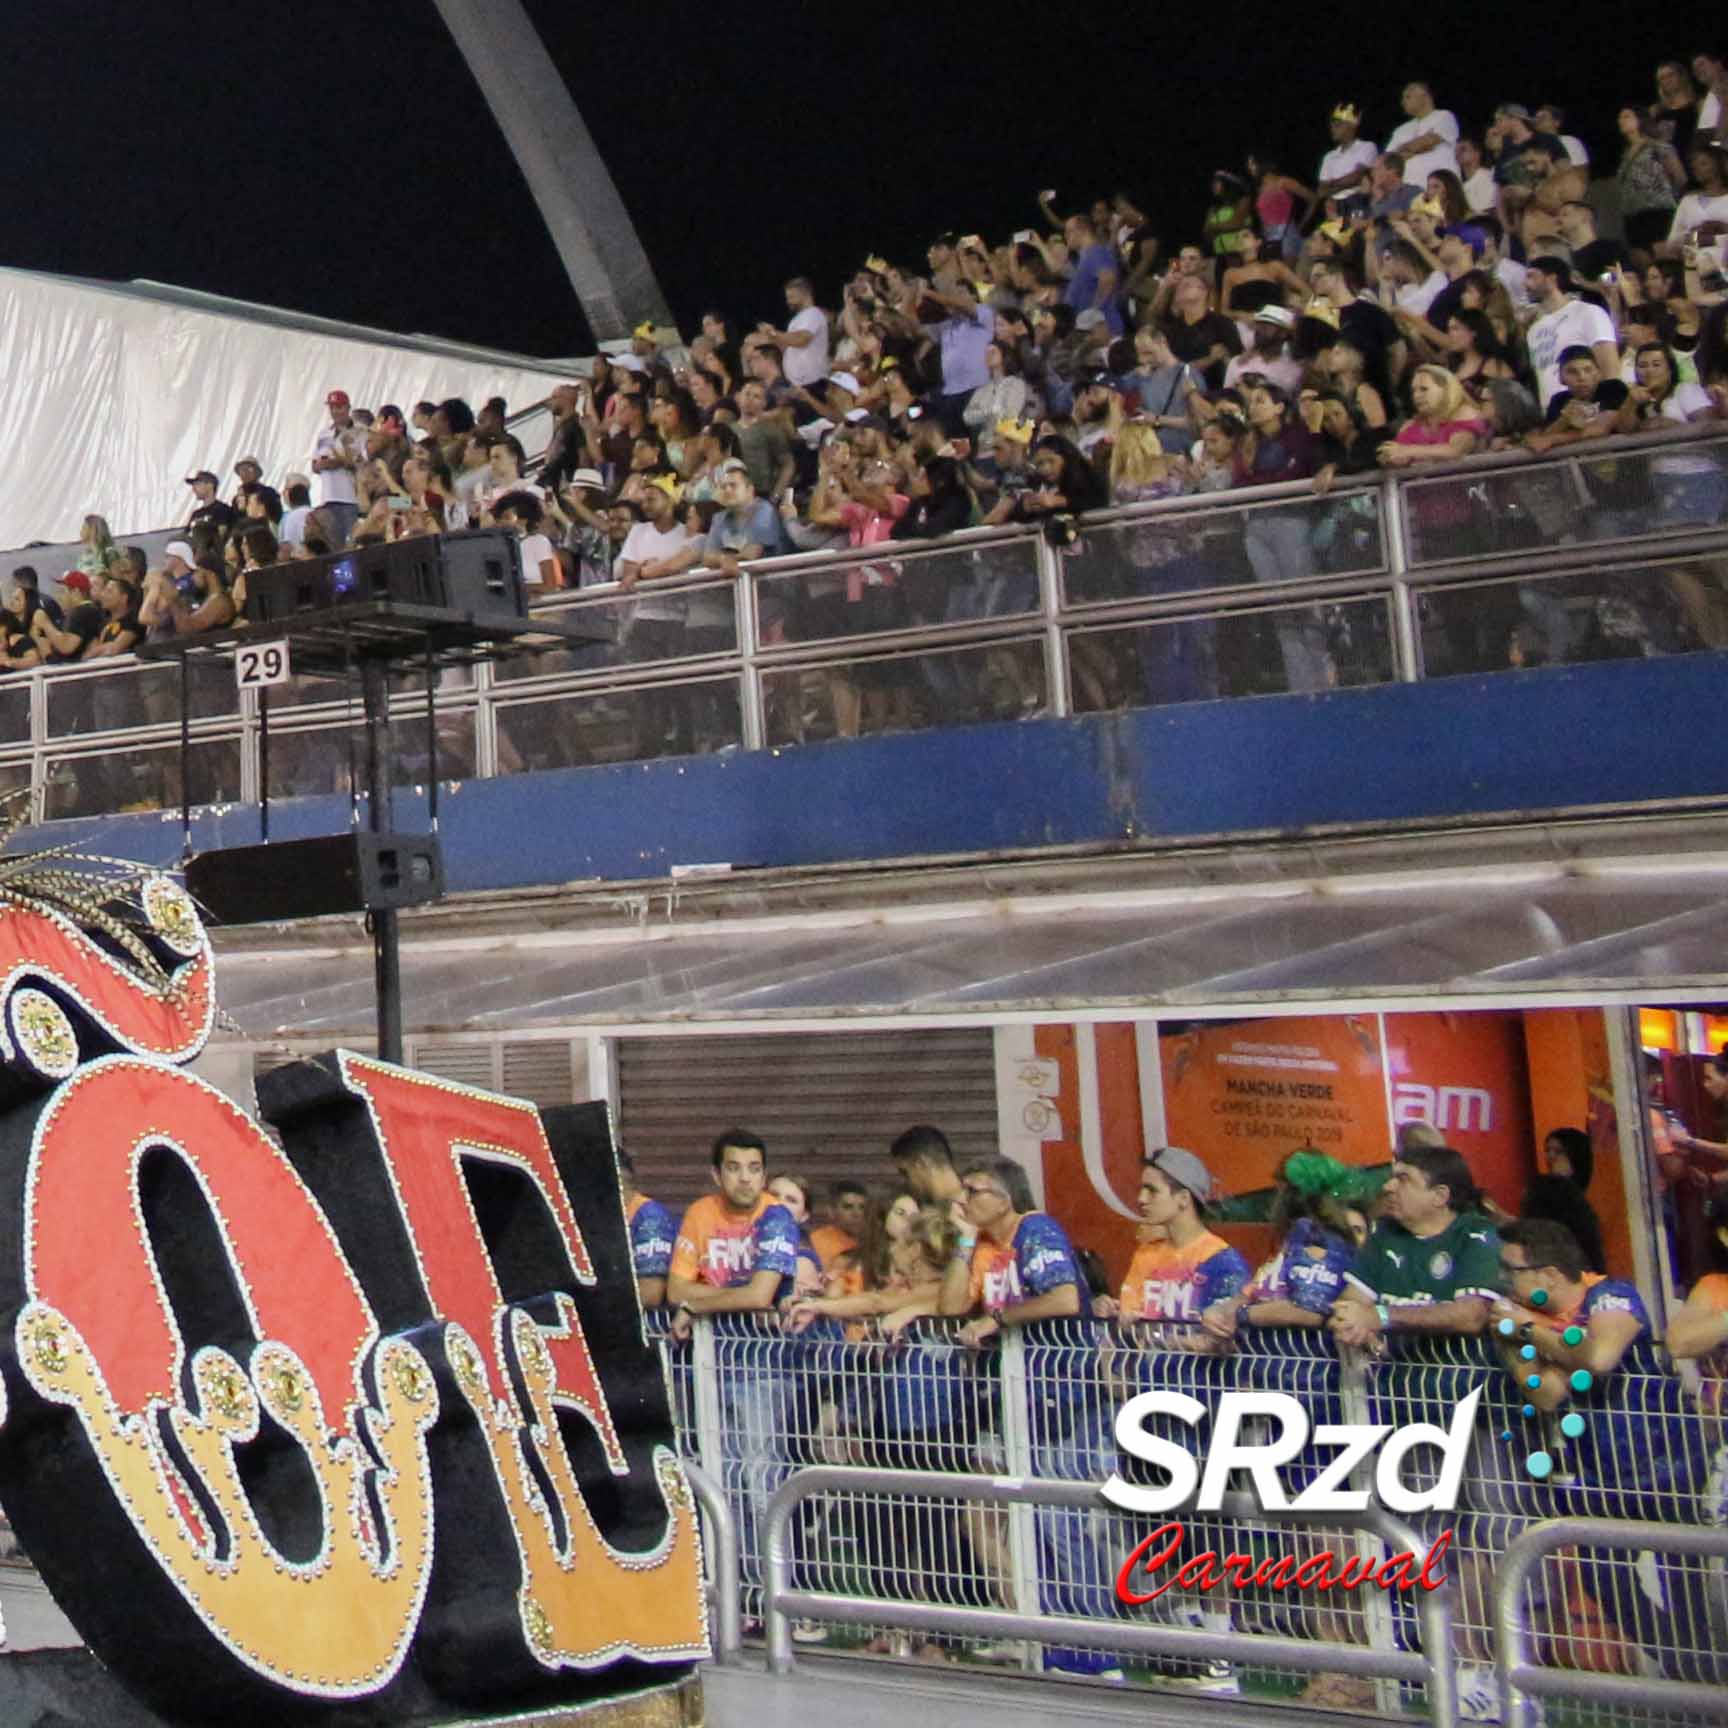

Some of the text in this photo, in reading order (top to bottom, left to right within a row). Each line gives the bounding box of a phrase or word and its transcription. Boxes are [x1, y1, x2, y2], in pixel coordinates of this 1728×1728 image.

[241, 648, 282, 683] 29
[1226, 1079, 1334, 1100] MANCHA VERDE
